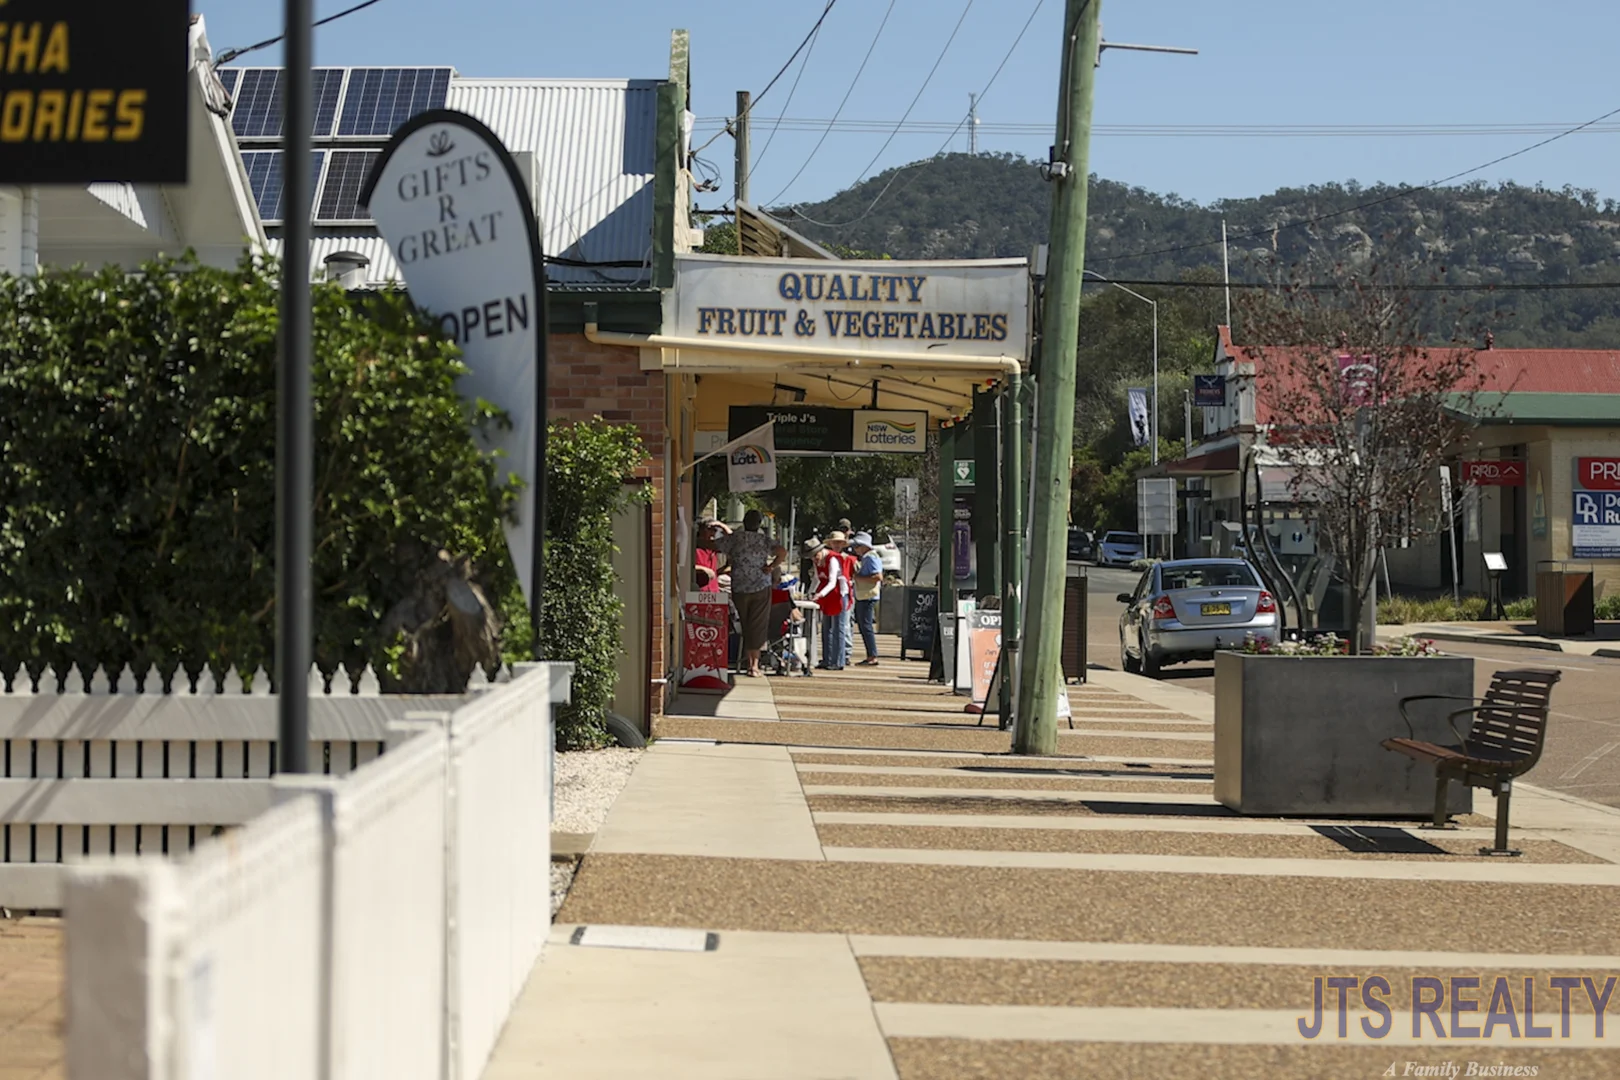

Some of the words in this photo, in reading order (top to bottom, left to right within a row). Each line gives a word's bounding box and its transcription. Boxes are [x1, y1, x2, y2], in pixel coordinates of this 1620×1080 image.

[397, 151, 491, 202] GIFTS
[428, 194, 457, 223] R
[397, 211, 503, 265] GREAT
[778, 272, 926, 302] QUALITY
[440, 293, 529, 345] OPEN
[697, 306, 787, 337] FRUIT
[794, 308, 817, 338] &
[824, 310, 1007, 342] VEGETABLES
[766, 412, 798, 424] Triple
[799, 413, 817, 424] J's
[867, 424, 888, 432] NSW
[865, 432, 917, 445] Lotteries
[731, 453, 758, 465] Lott
[698, 593, 717, 603] OPEN
